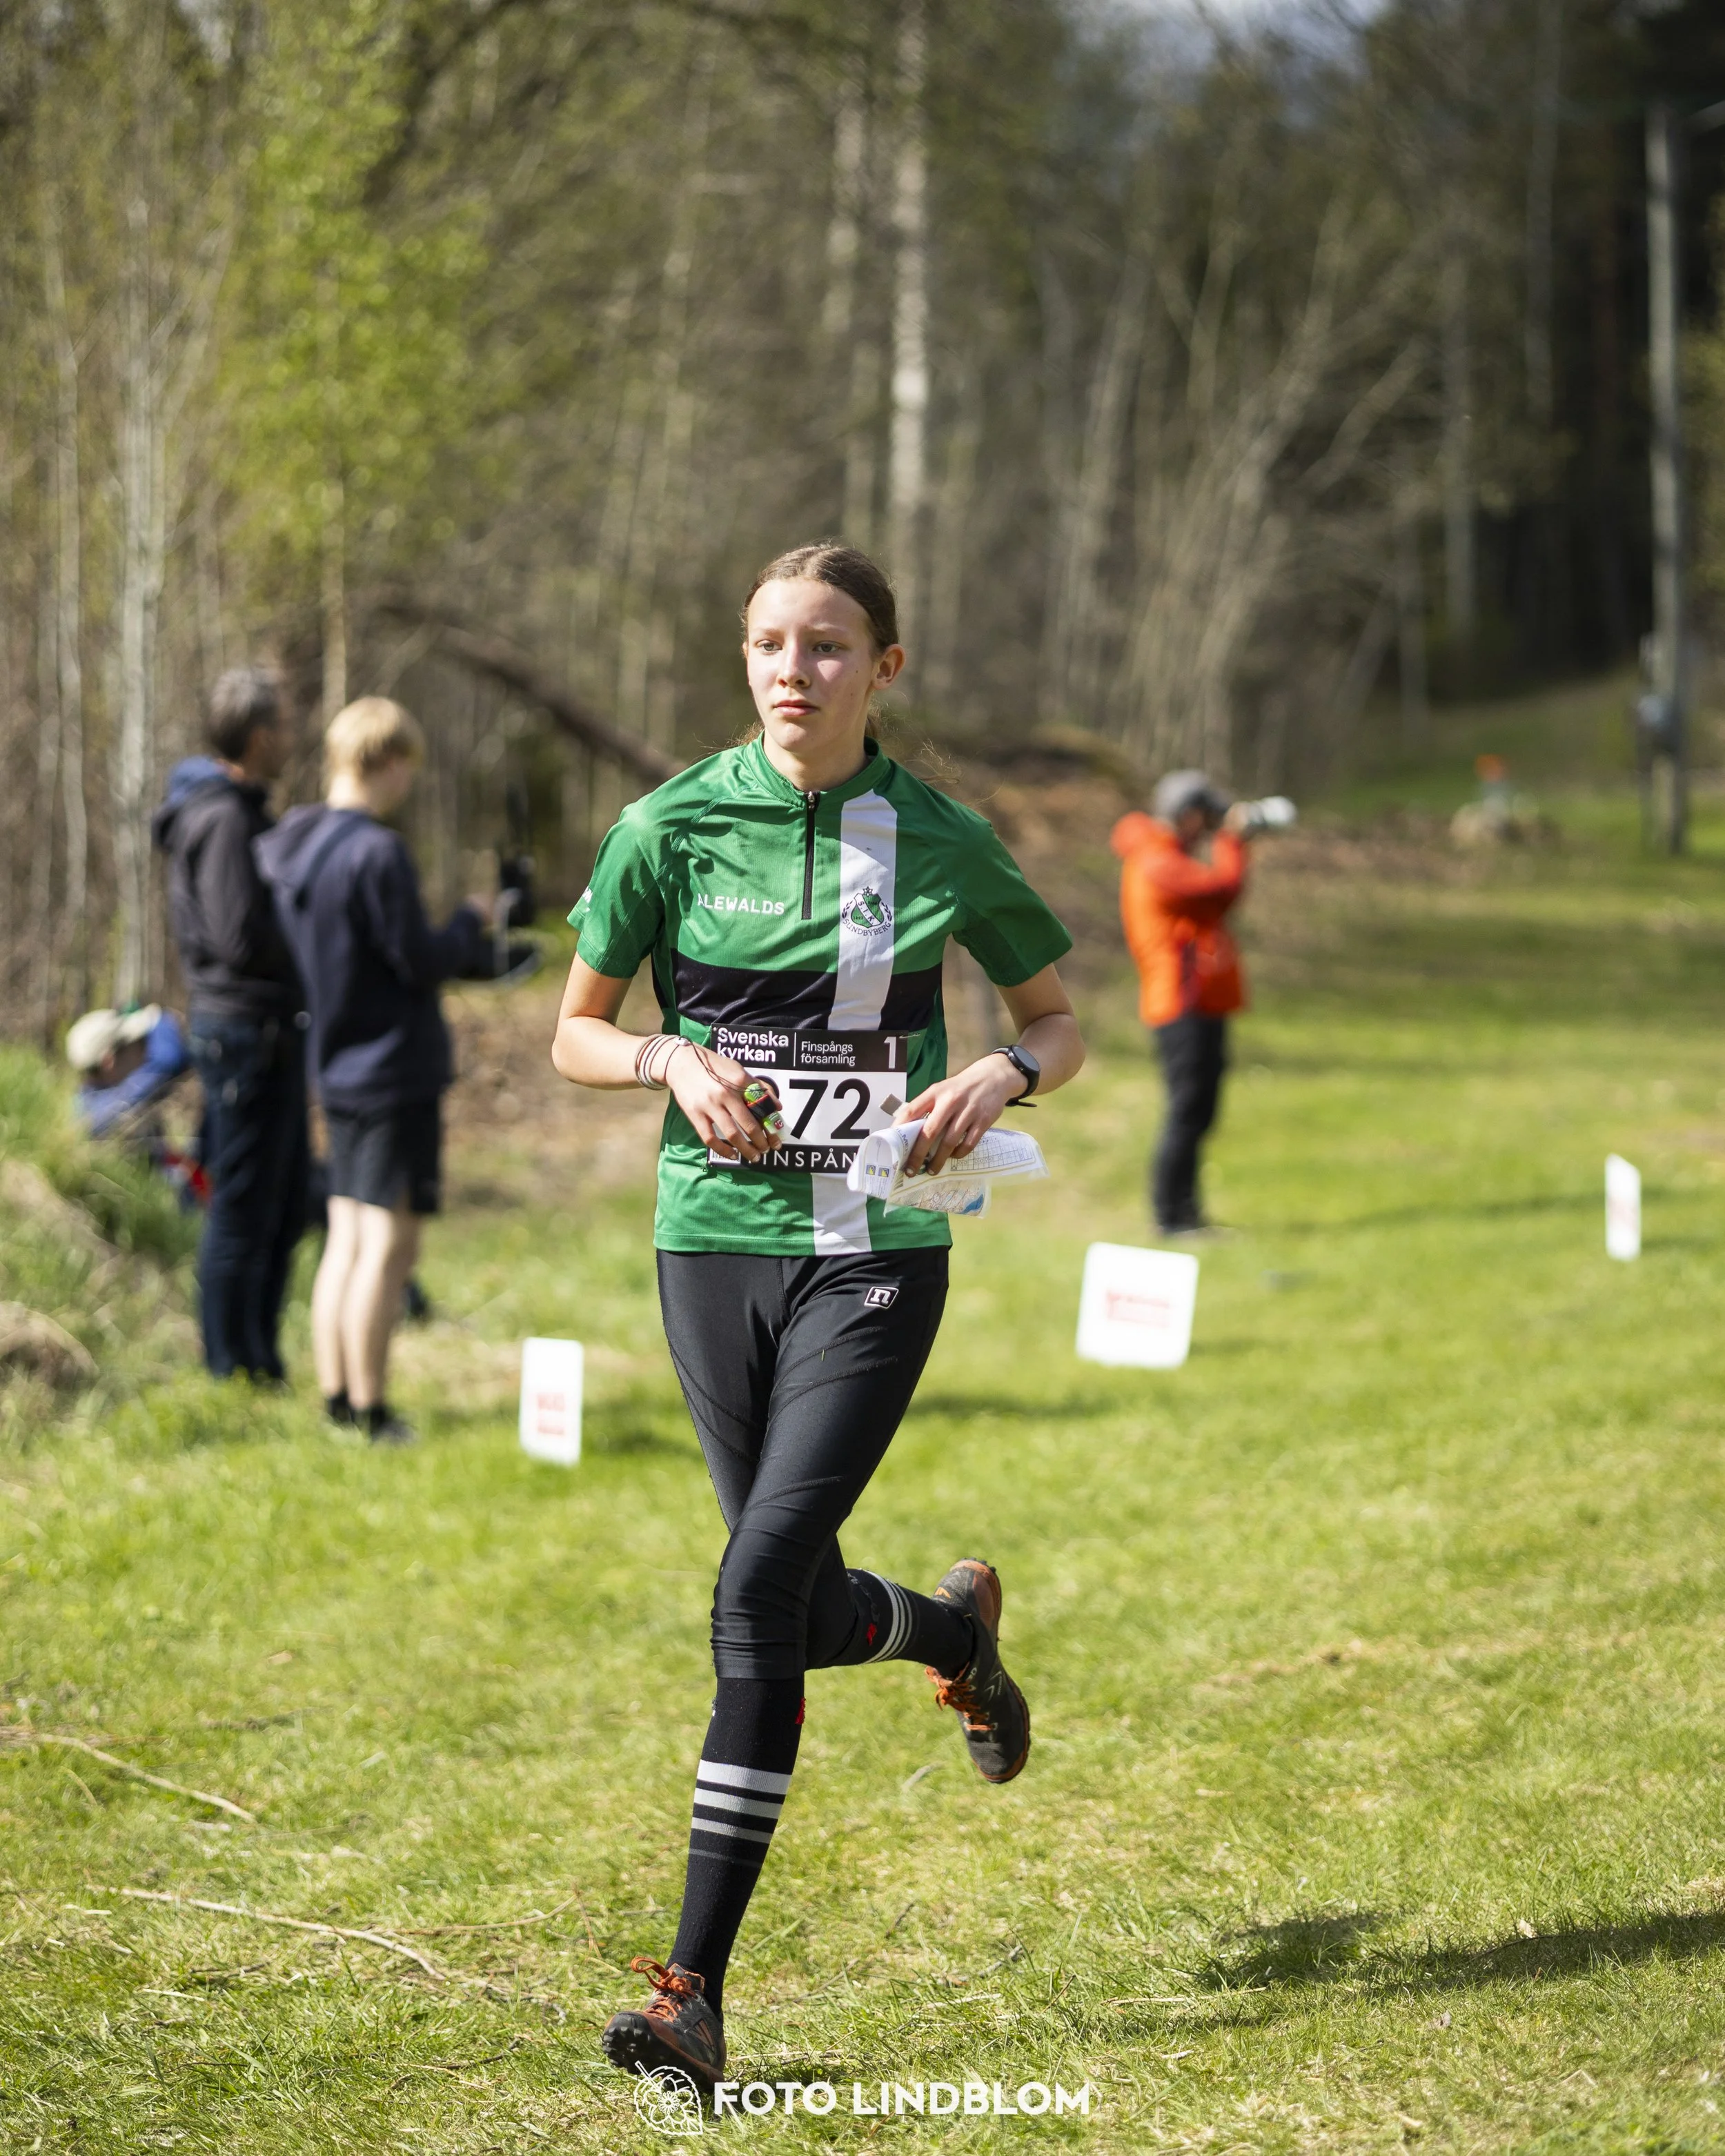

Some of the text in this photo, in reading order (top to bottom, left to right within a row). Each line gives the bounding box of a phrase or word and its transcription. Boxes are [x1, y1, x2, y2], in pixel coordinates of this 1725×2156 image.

[698, 893, 785, 916] ALEWALDS
[842, 919, 891, 936] SUNDBYBERG
[718, 1027, 789, 1047] Svenska
[801, 1040, 854, 1054] Finspångs
[718, 1042, 776, 1062] kyrkan
[800, 1053, 856, 1067] församling
[884, 1036, 897, 1069] 1
[755, 1074, 871, 1140] 72
[749, 1148, 856, 1168] INSPÅN
